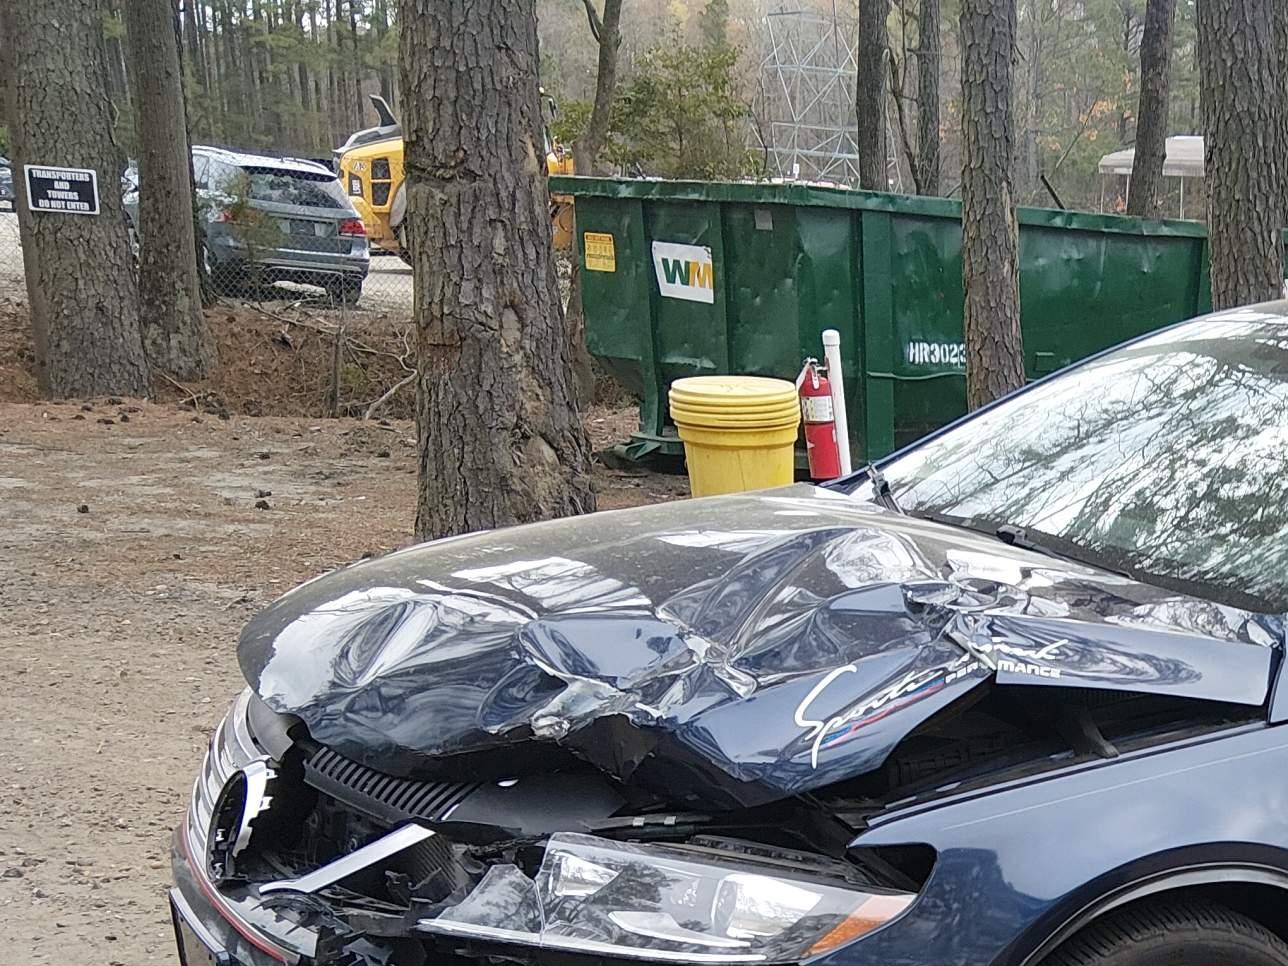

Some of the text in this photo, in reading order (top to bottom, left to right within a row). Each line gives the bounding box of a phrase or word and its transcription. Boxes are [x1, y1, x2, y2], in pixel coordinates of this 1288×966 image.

[31, 169, 90, 181] TRANSPORTERS
[53, 180, 70, 190] AND
[46, 189, 79, 200] TOWERS
[38, 199, 90, 211] DO NOT ENTER
[661, 257, 712, 290] WM
